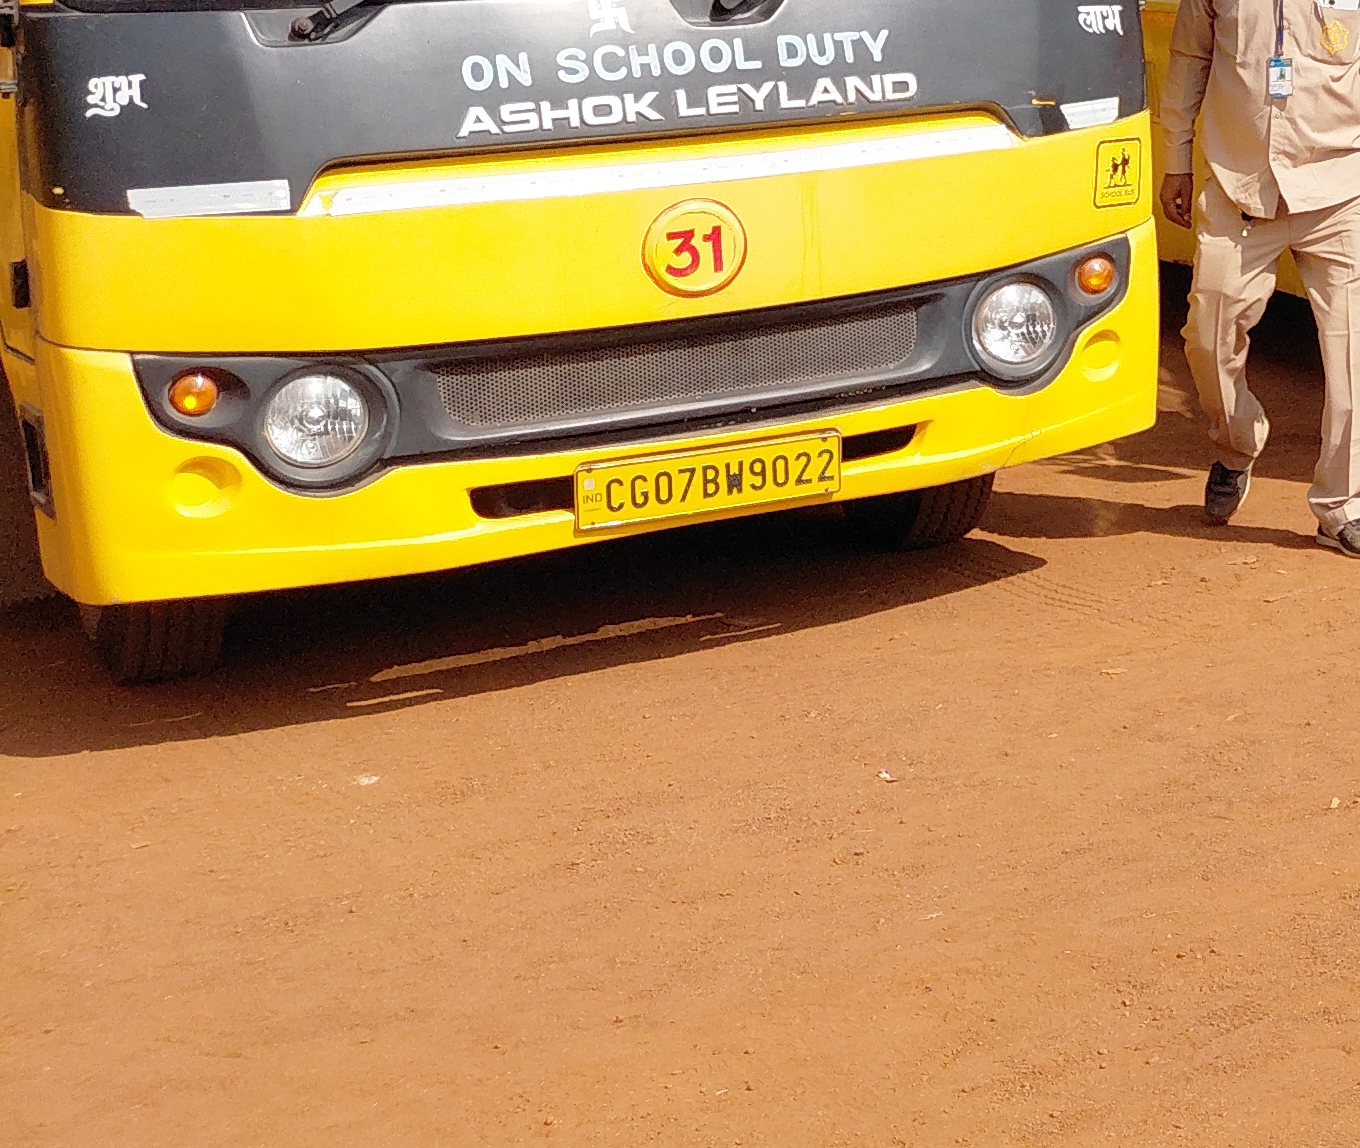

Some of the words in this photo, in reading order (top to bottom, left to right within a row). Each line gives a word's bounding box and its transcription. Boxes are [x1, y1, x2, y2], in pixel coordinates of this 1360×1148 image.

[1077, 5, 1124, 36] लाभ
[461, 51, 532, 91] ON
[556, 37, 763, 85] SCHOOL
[776, 28, 891, 69] DUTY
[85, 73, 149, 118] शुभ
[456, 91, 665, 139] ASHOK
[676, 71, 918, 120] LEYLAND
[663, 223, 727, 278] 31
[582, 492, 603, 504] IND
[605, 448, 835, 513] CG07BW9022
